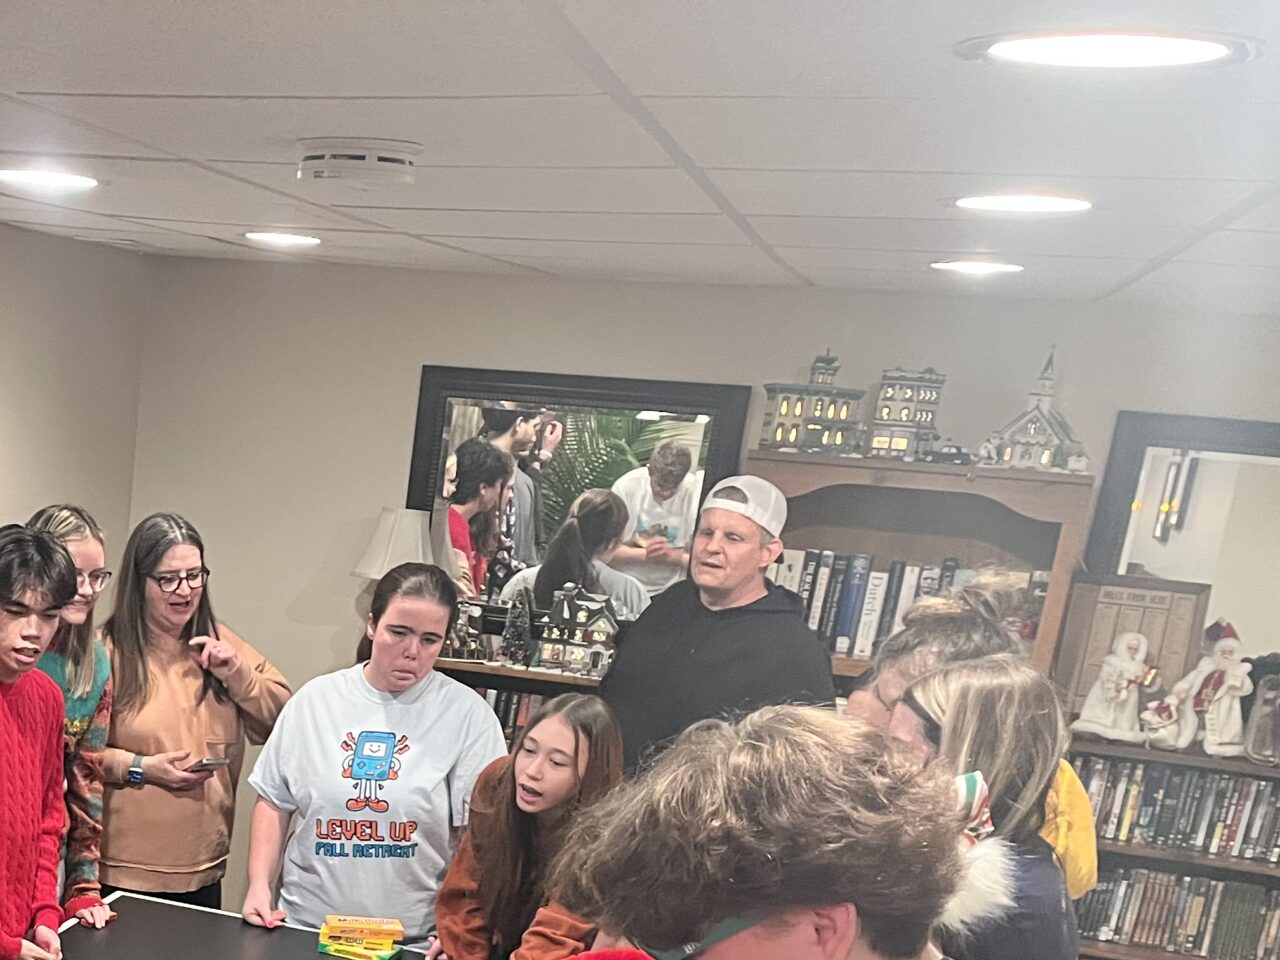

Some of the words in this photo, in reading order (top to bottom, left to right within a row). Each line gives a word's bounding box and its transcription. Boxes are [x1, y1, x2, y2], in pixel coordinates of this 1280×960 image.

[863, 576, 884, 616] Dutch
[316, 818, 385, 841] LEVEL
[389, 821, 418, 842] UP
[315, 842, 349, 857] FALL
[352, 843, 418, 858] RETREAT
